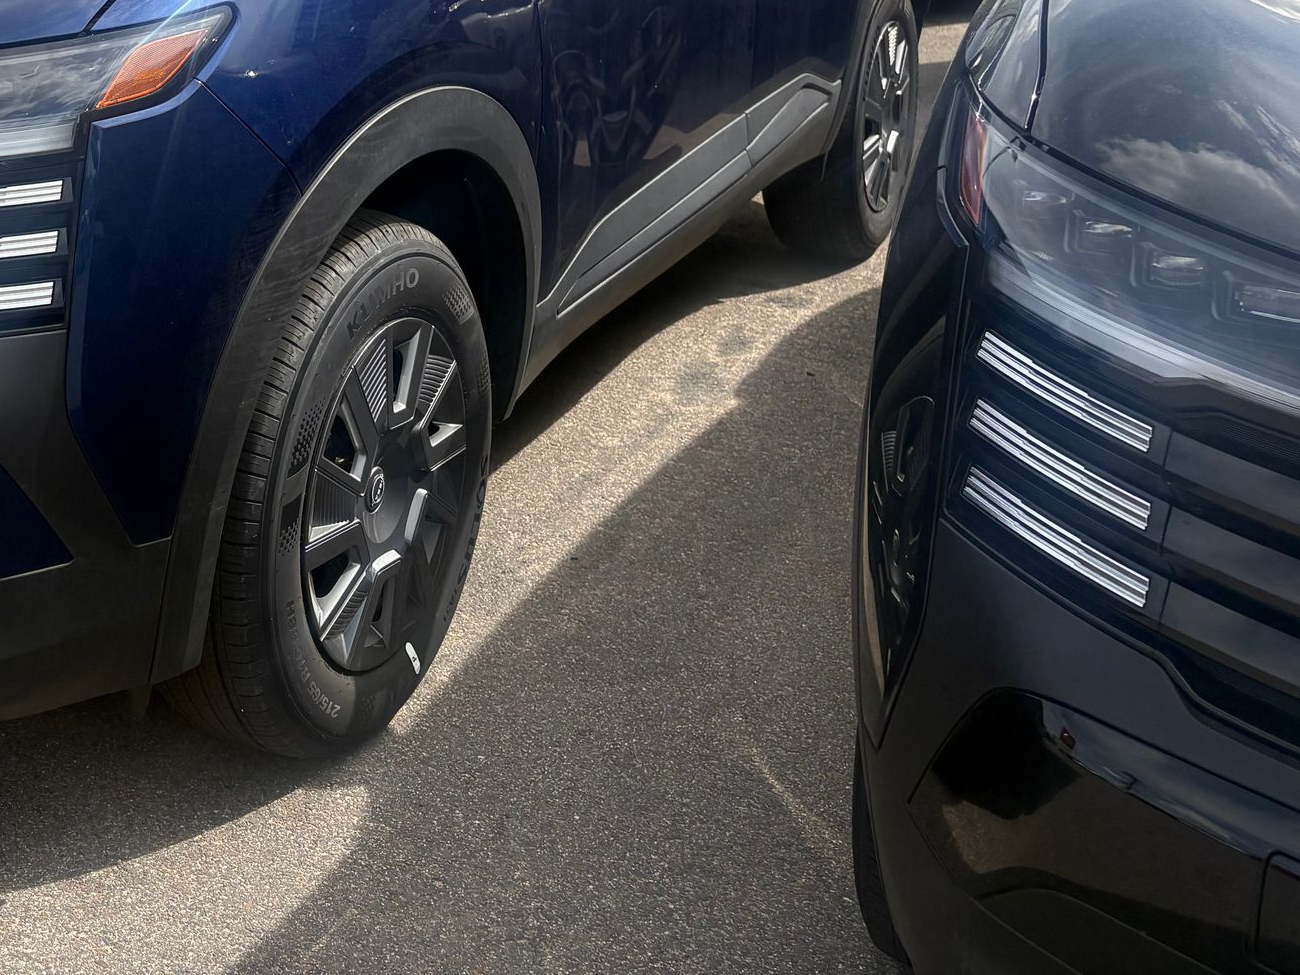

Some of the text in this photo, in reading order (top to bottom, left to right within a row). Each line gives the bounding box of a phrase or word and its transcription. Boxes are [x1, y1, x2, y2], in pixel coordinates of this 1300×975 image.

[345, 266, 421, 343] KUMHO
[457, 454, 489, 587] SOLUS
[307, 680, 342, 719] 215/65
